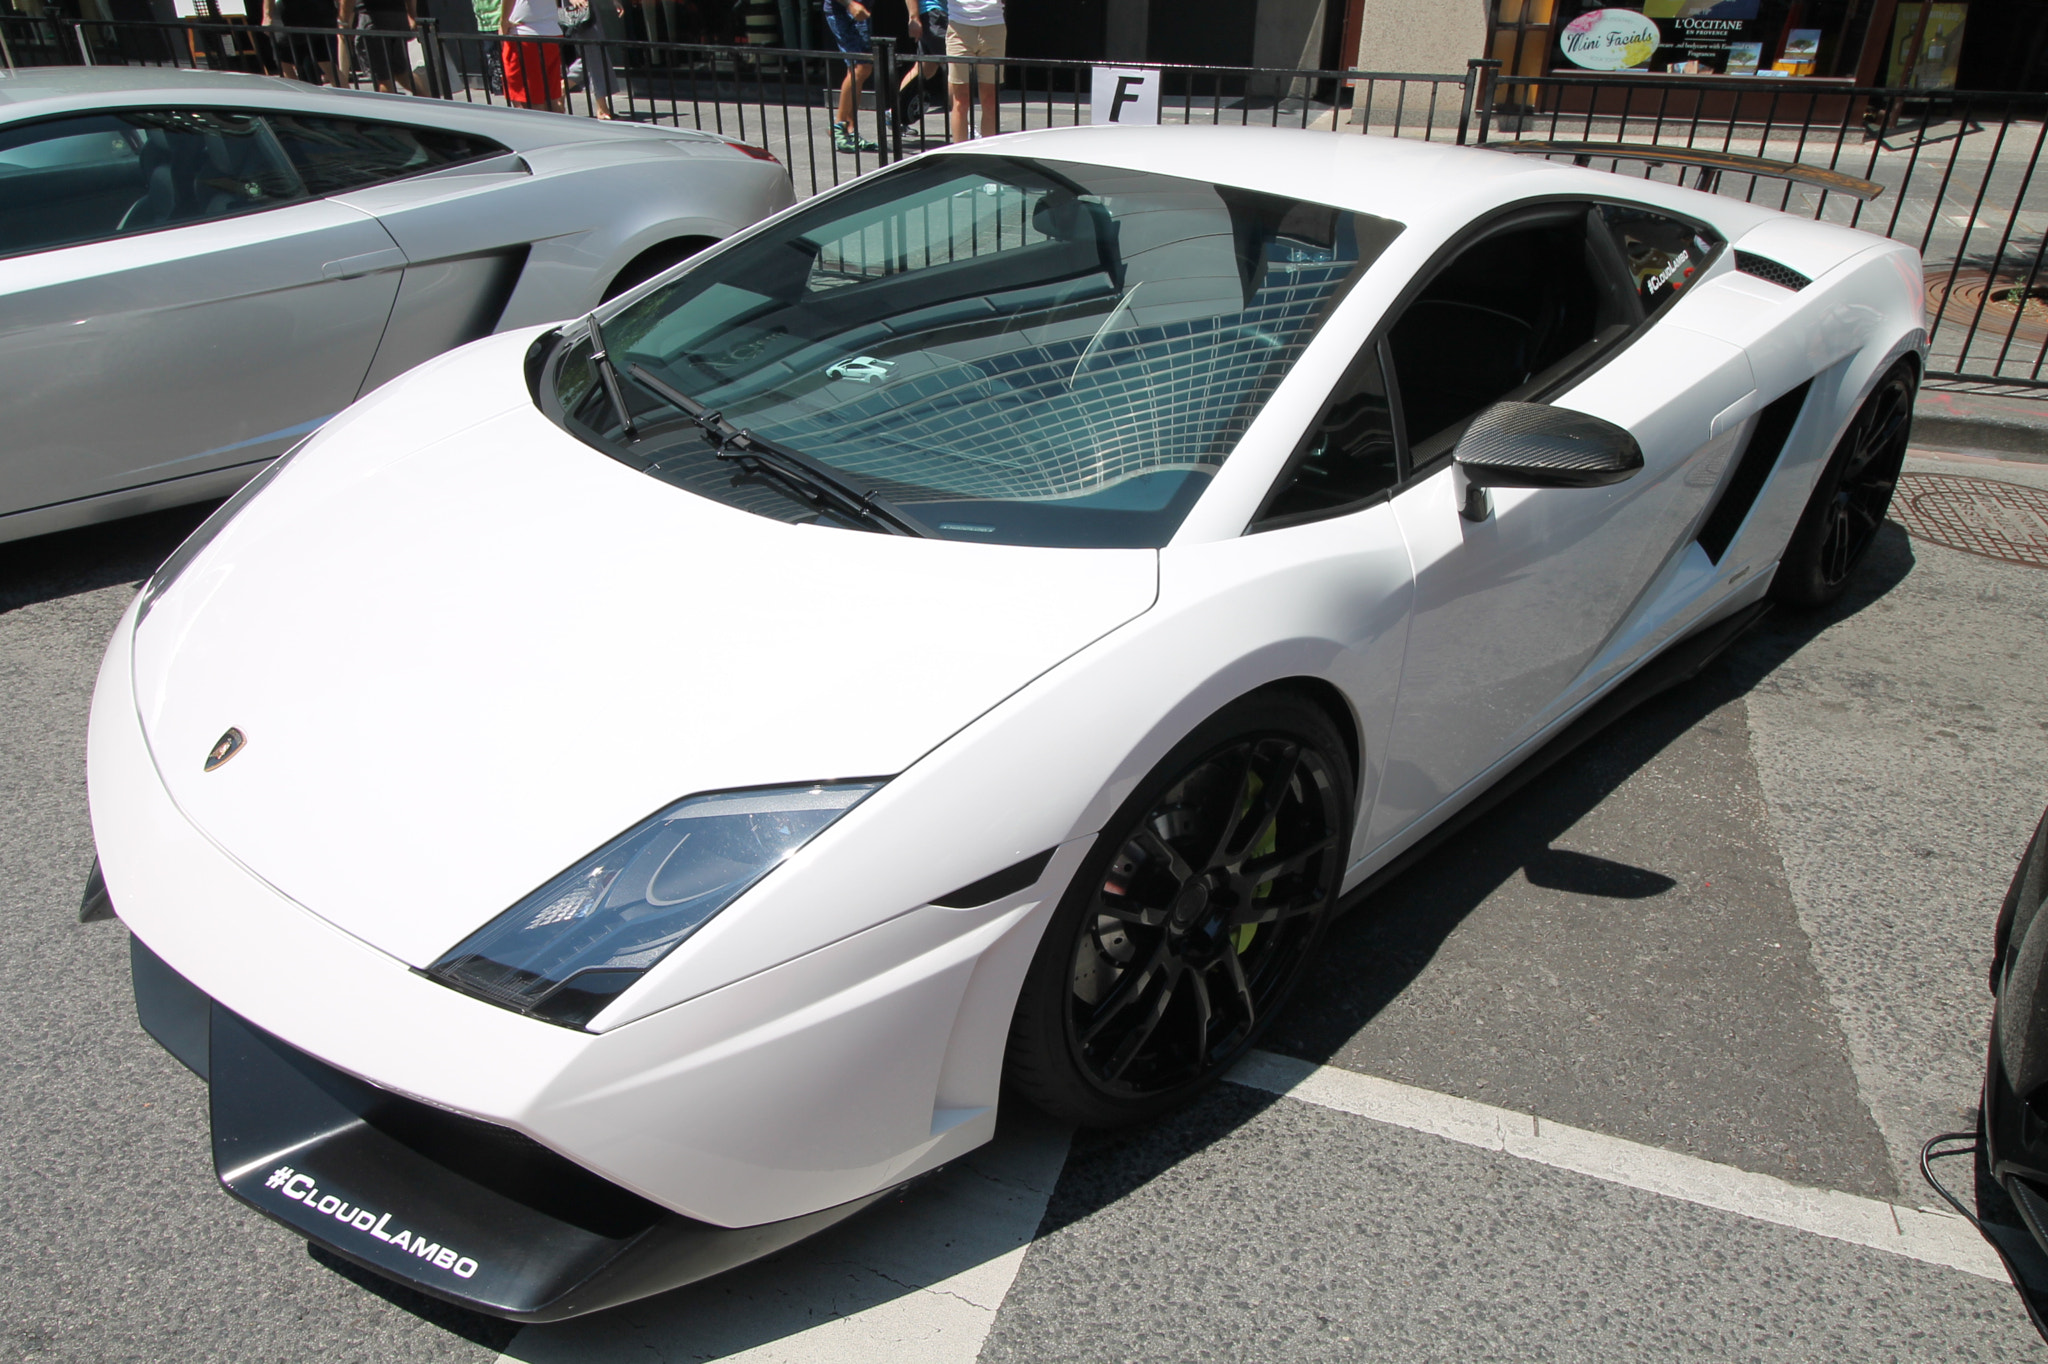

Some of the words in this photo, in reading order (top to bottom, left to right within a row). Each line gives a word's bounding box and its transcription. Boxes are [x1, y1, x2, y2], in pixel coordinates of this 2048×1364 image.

[1675, 18, 1743, 30] L'OCCITANE
[1567, 32, 1601, 53] Mini
[1606, 27, 1652, 47] Facials
[1109, 76, 1145, 122] F
